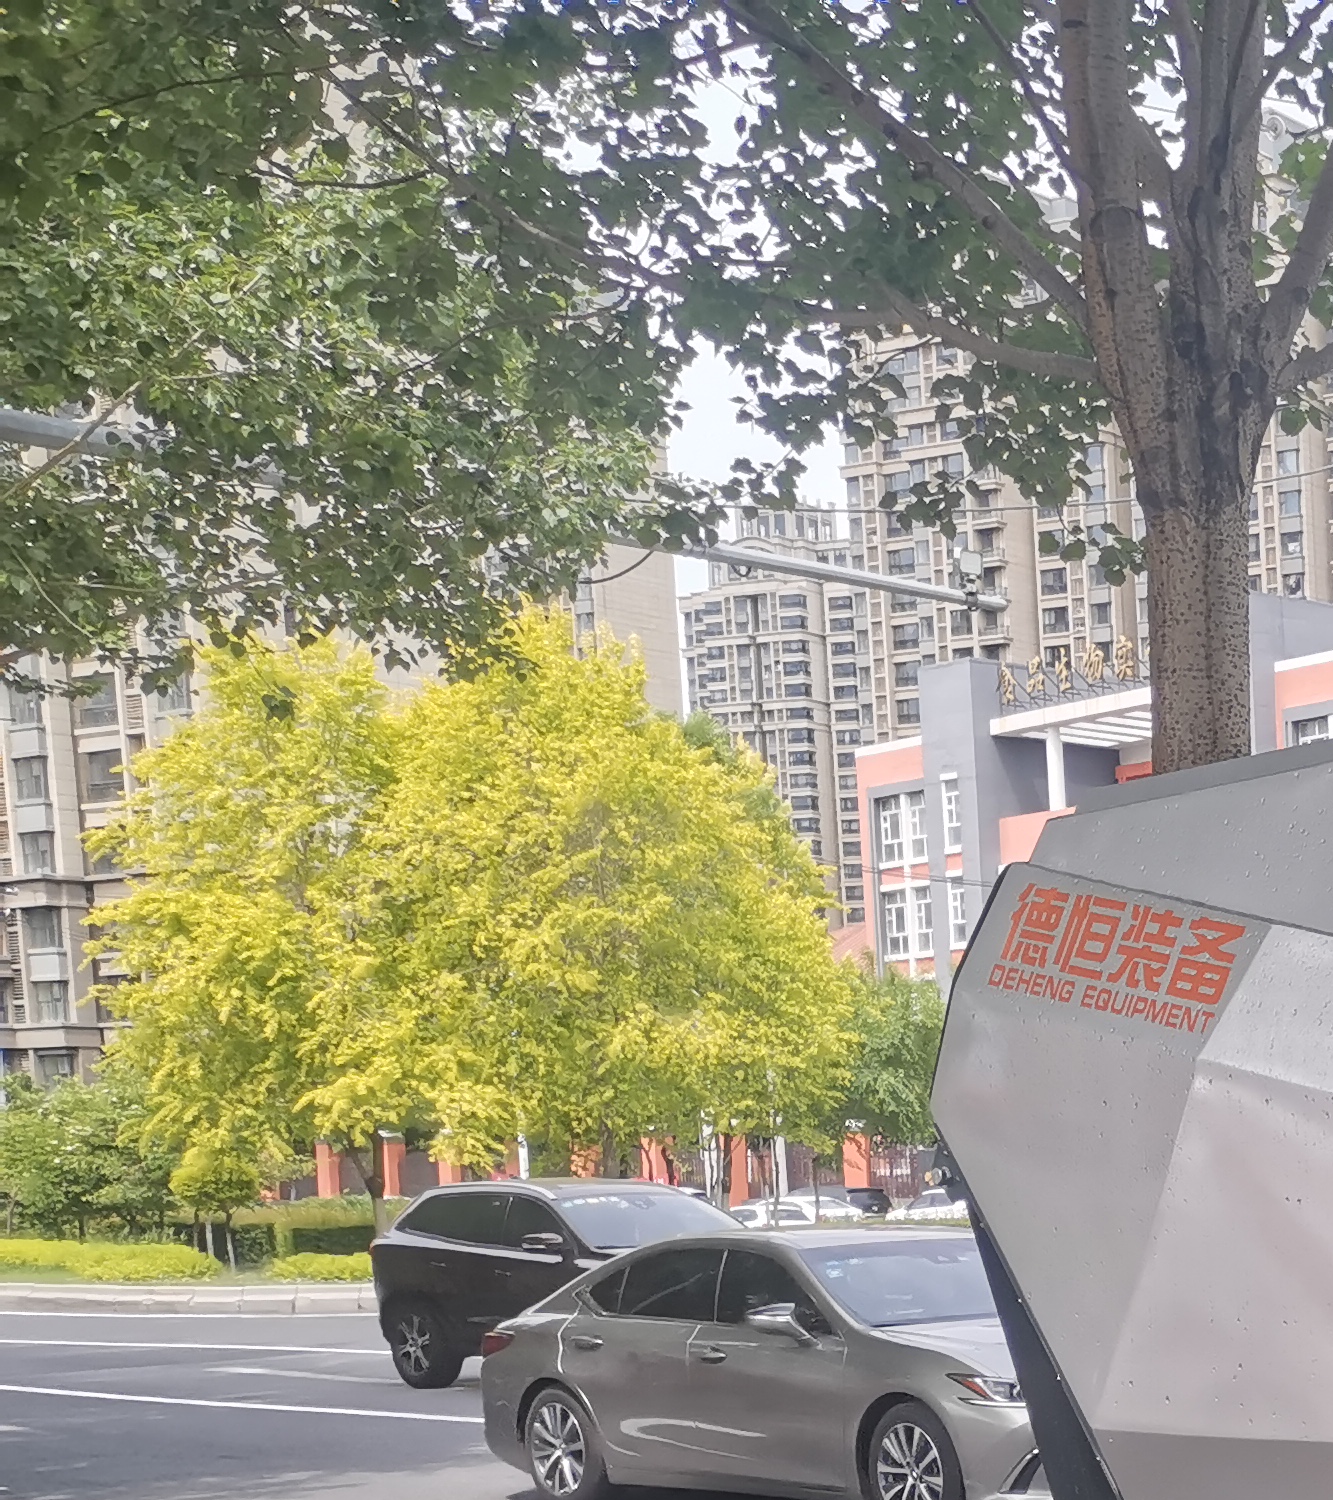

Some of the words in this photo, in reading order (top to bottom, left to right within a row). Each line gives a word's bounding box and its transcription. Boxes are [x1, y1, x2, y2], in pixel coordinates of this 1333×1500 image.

[999, 634, 1150, 705] 食品生物实
[1000, 882, 1247, 1006] 德恒装备
[988, 963, 1075, 1003] DEHENG
[1079, 985, 1216, 1035] EQUIPMENT
